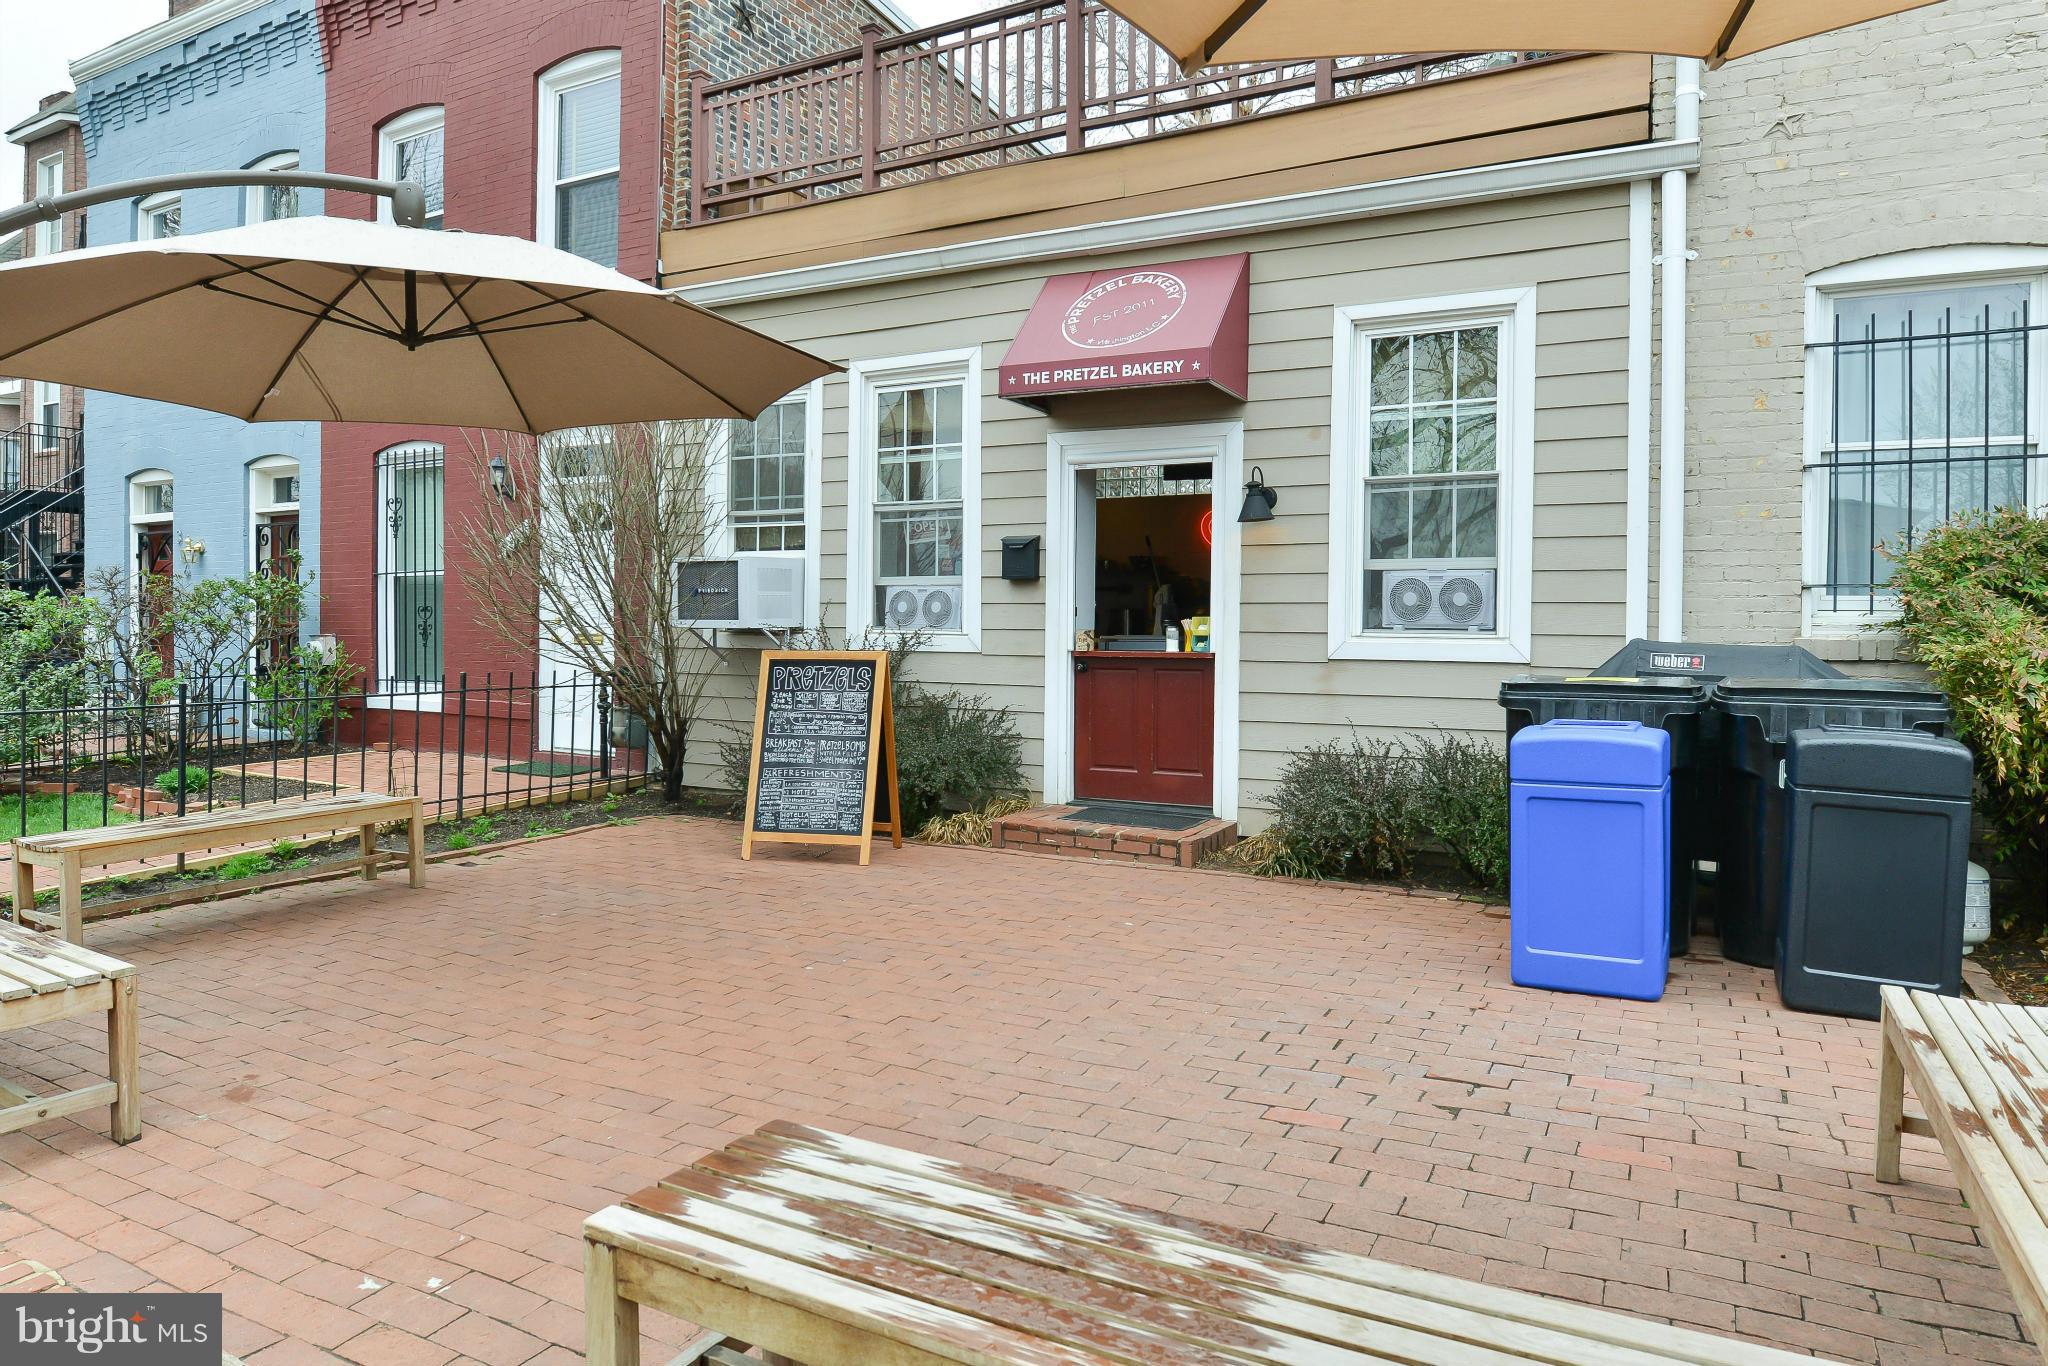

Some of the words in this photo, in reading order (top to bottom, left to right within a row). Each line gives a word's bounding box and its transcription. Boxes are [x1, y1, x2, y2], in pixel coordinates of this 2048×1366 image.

[1067, 279, 1128, 324] PRETZEL
[1131, 274, 1182, 300] BAKERY
[1123, 298, 1155, 314] 2011
[1022, 370, 1050, 385] THE
[1053, 365, 1118, 383] PRETZEL
[1122, 359, 1185, 377] BAKERY
[1654, 653, 1691, 668] weber
[765, 738, 802, 748] BREAKFAST
[845, 740, 866, 752] BOMB
[773, 770, 852, 780] REFRESHMENTS
